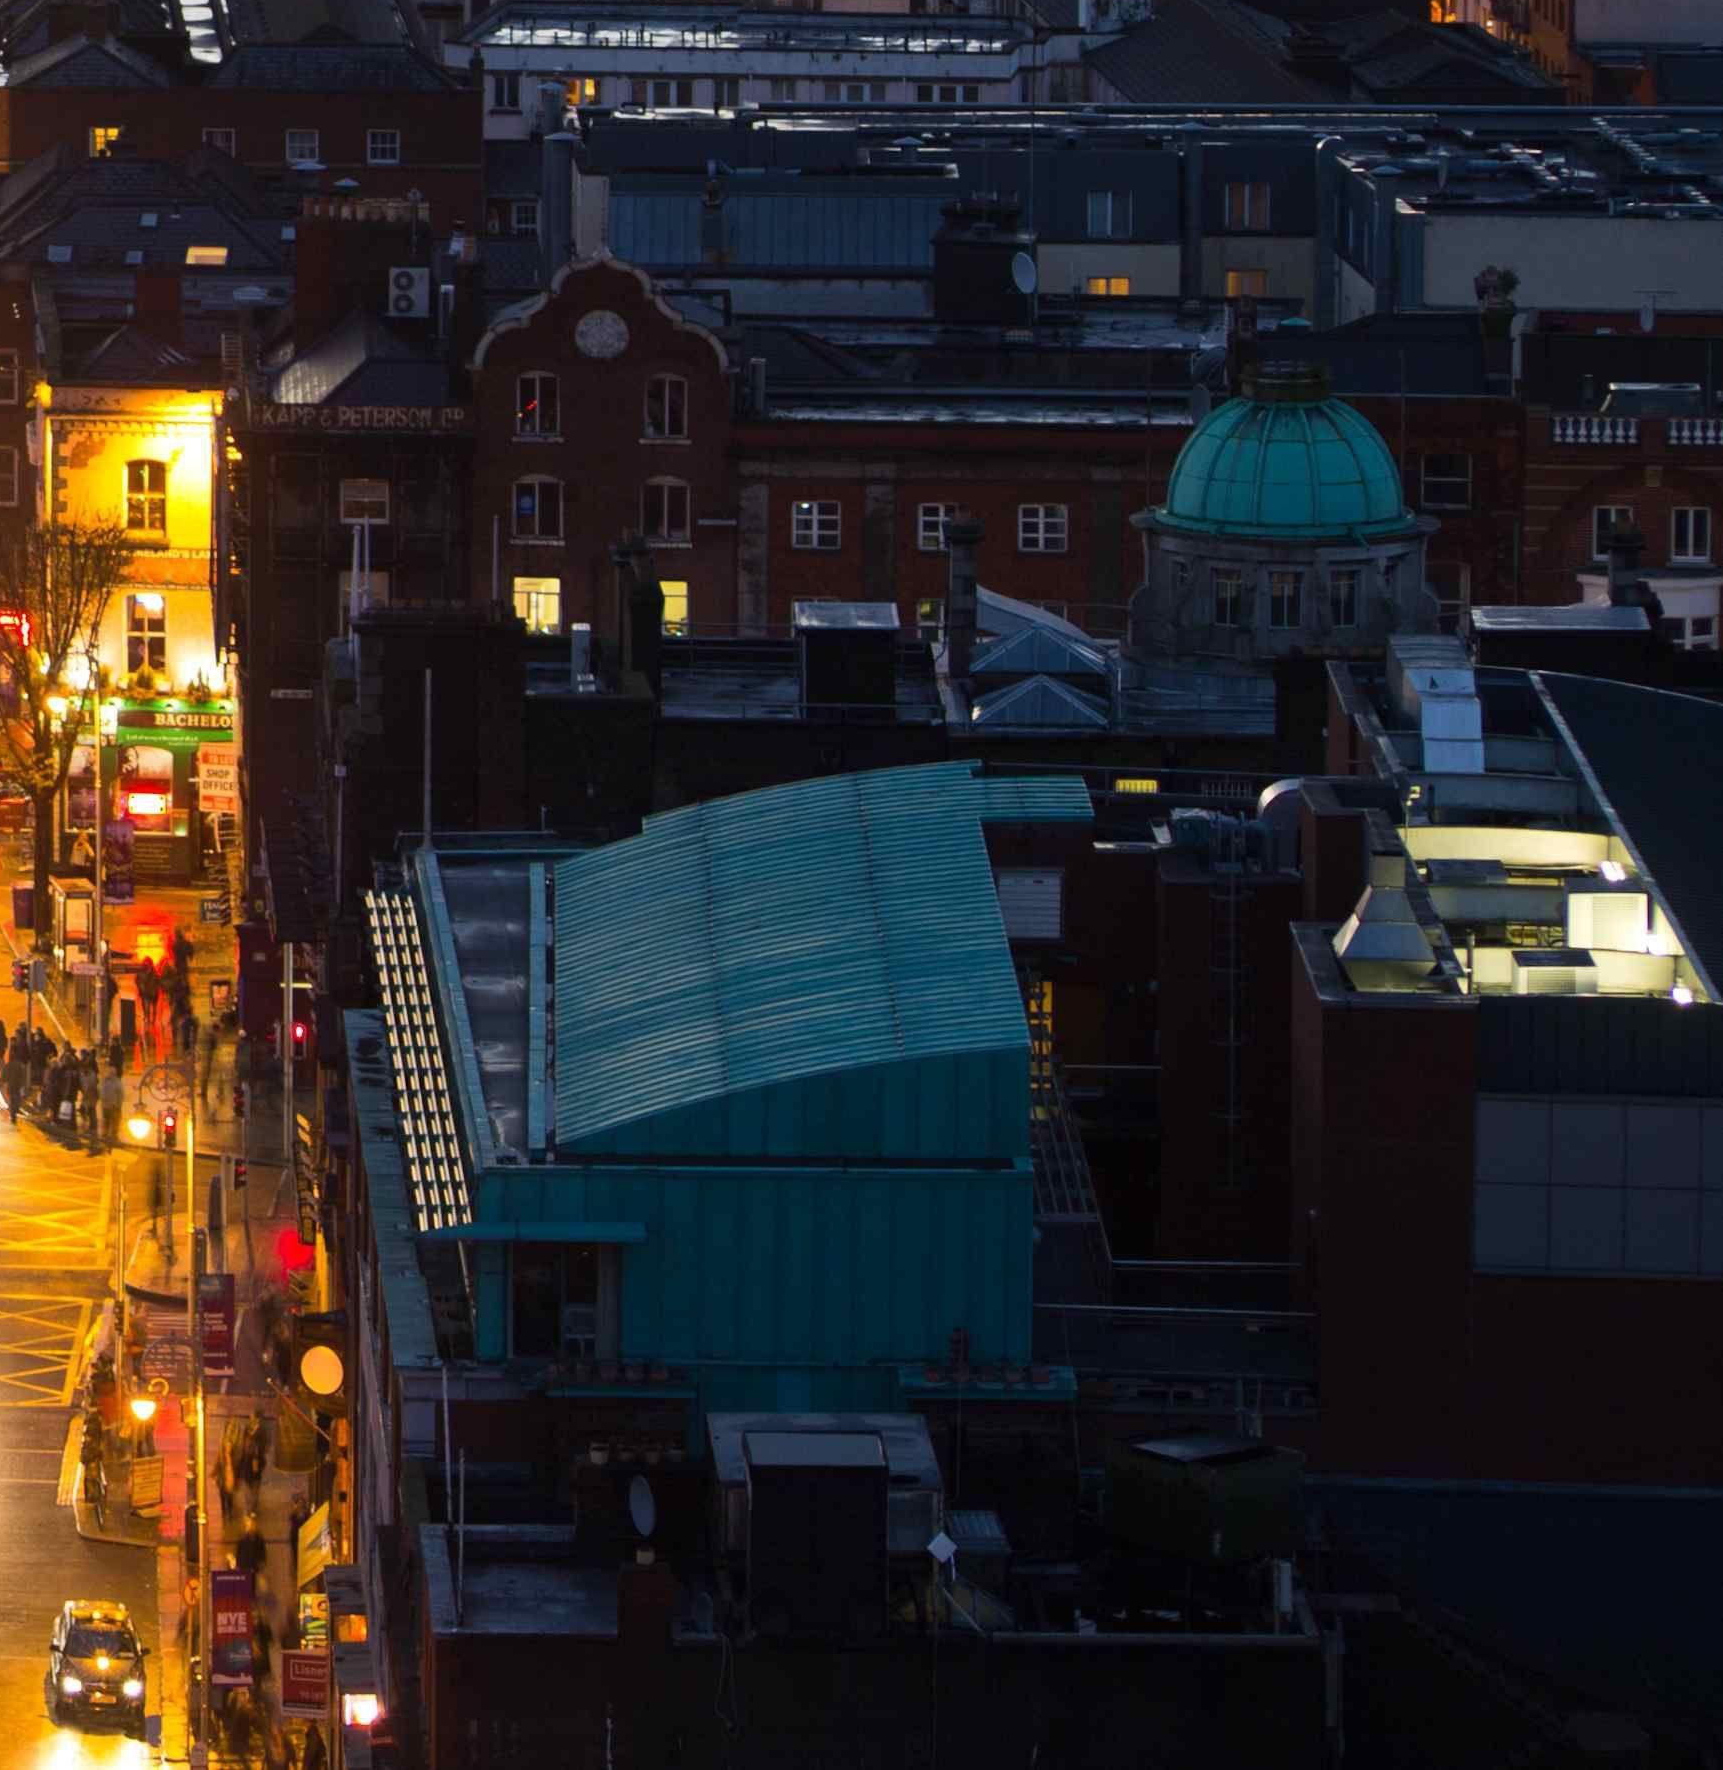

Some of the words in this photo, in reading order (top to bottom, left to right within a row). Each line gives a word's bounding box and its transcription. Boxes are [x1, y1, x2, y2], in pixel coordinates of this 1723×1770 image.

[262, 406, 315, 426] KAPP
[338, 406, 432, 429] PETERSON
[206, 768, 230, 779] SHOP
[203, 781, 234, 791] OFFICE
[217, 1612, 247, 1625] NYE
